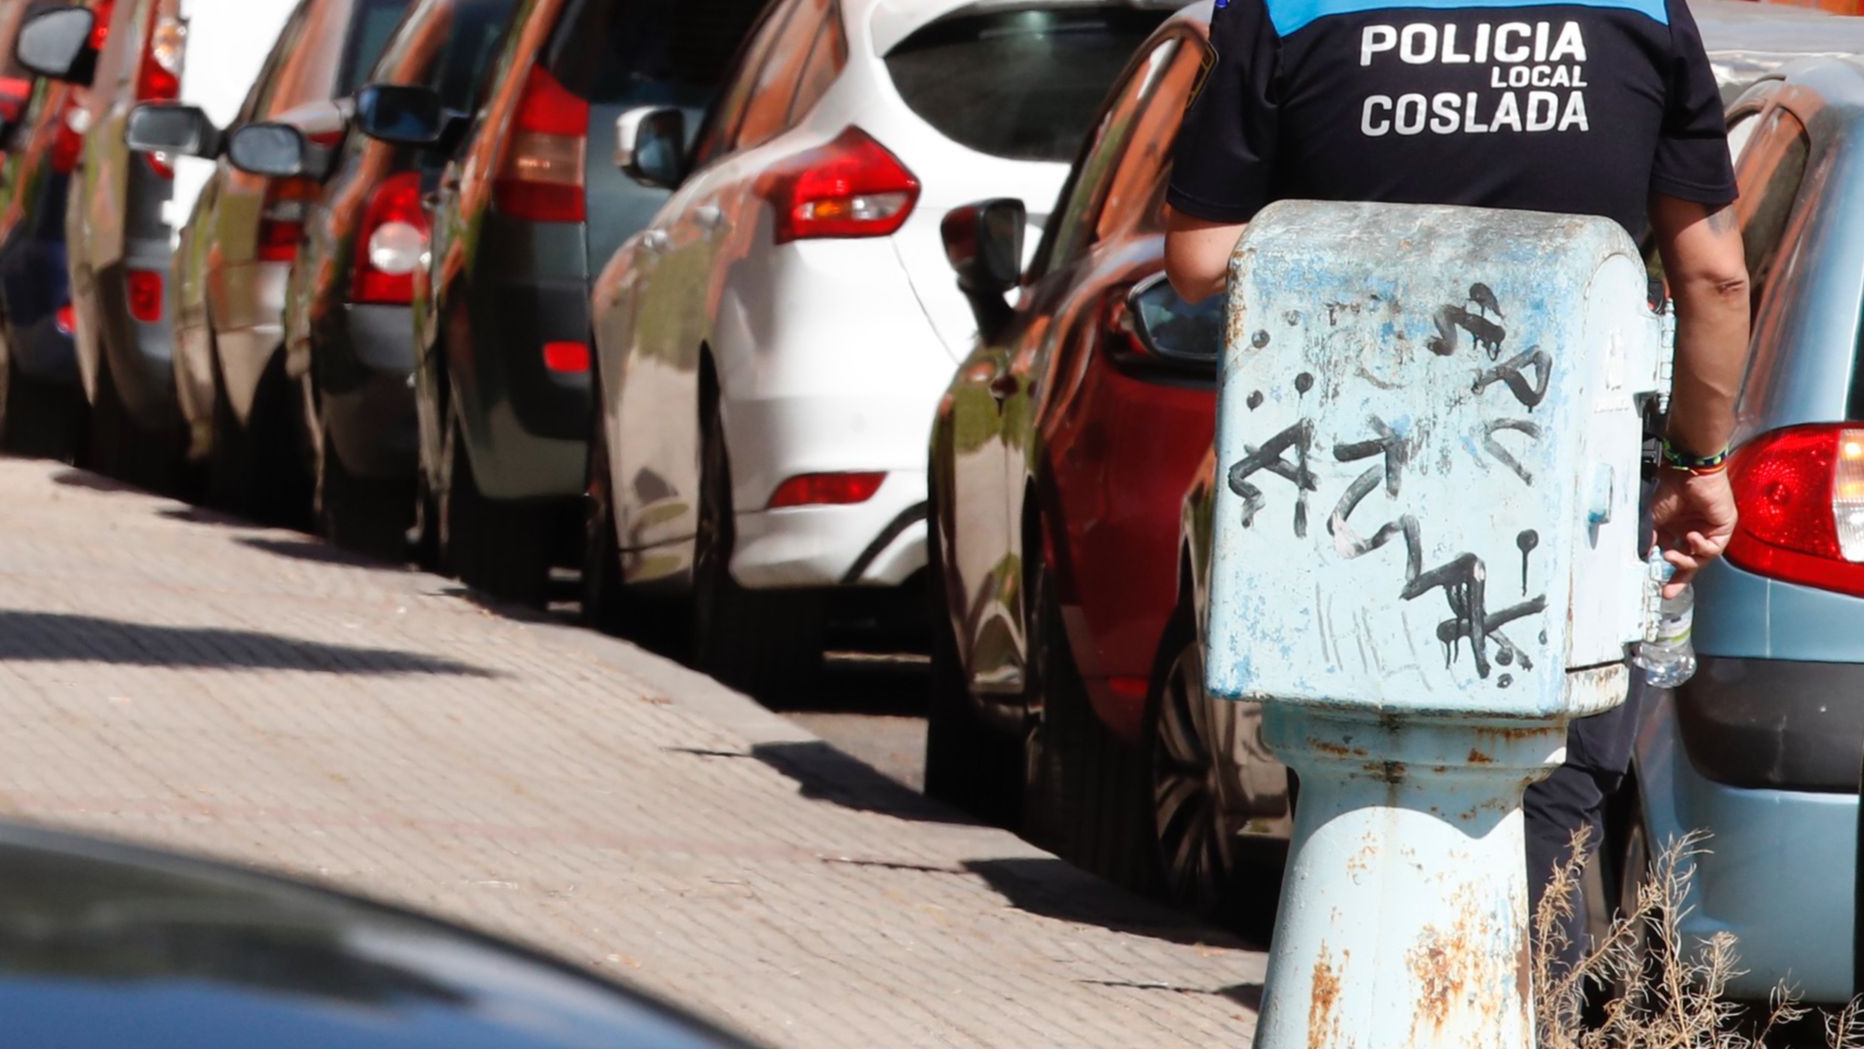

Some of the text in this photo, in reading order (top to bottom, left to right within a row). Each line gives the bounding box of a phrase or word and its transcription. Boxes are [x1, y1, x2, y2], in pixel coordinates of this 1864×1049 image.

[1359, 20, 1588, 67] POLICIA
[1490, 64, 1588, 89] LOCAL
[1360, 90, 1590, 138] COSLADA
